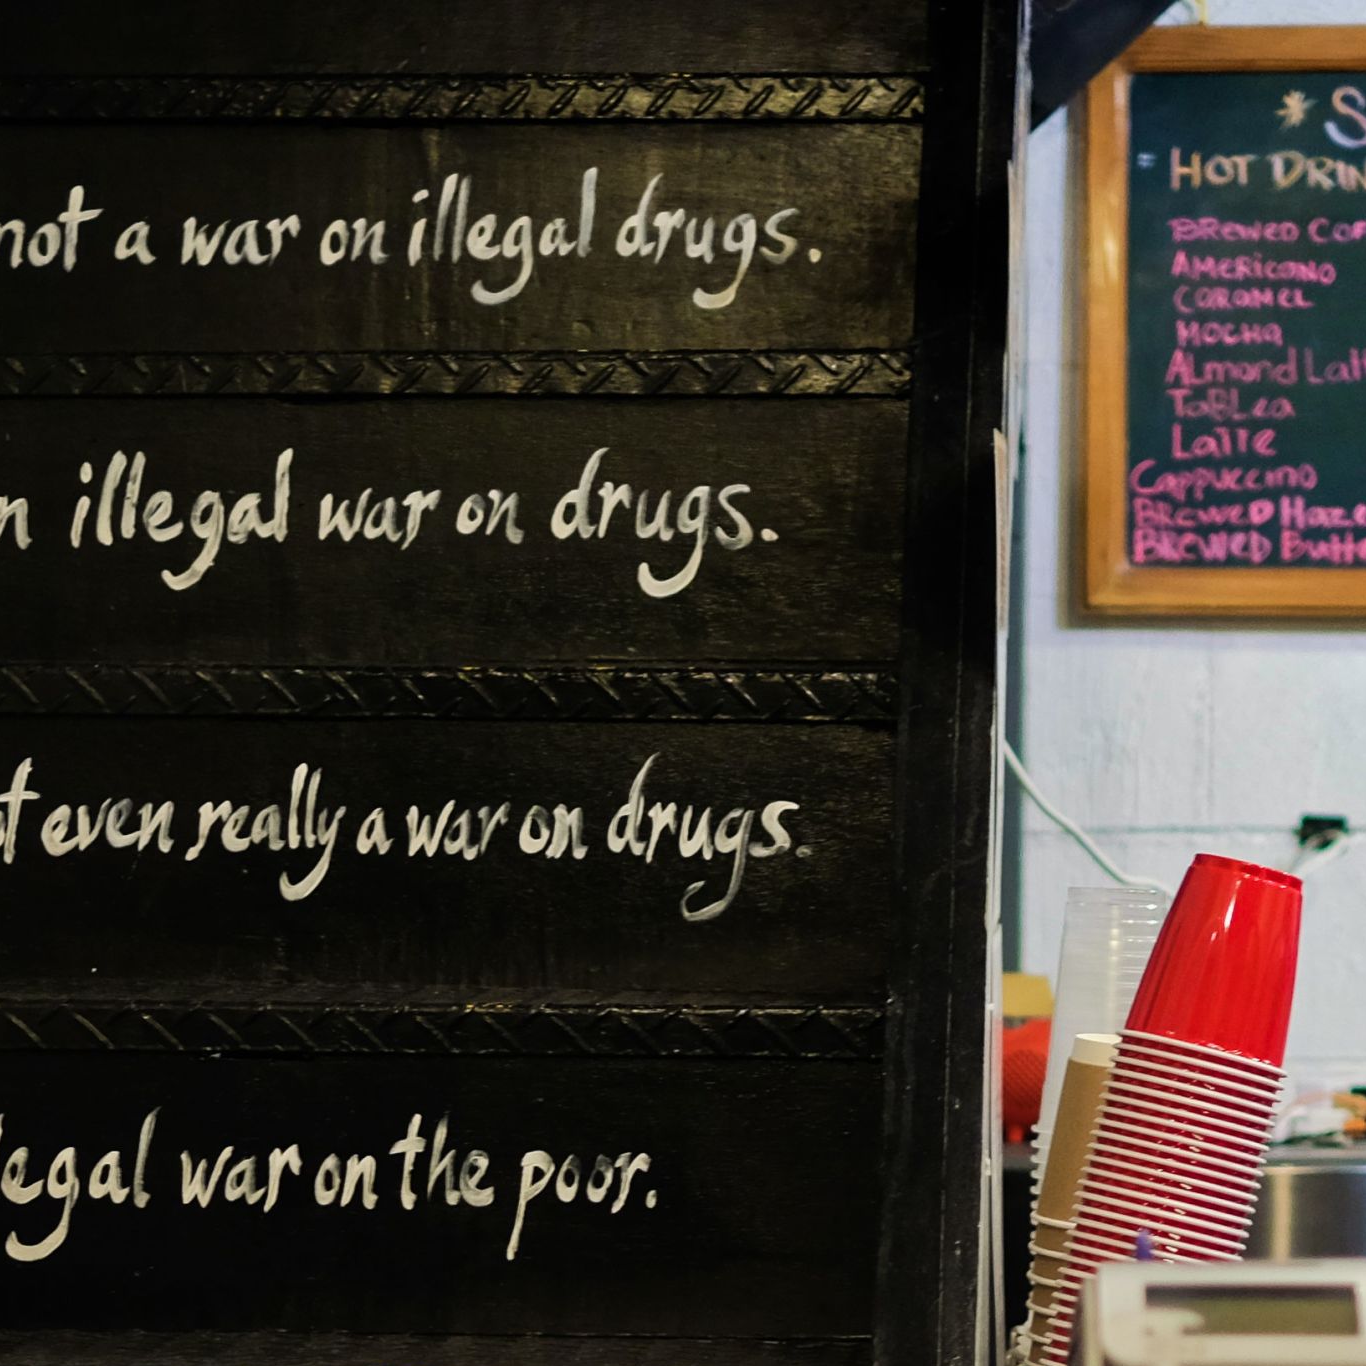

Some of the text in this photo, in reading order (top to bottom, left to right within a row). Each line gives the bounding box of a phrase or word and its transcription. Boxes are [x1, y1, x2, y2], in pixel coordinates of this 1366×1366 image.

[114, 217, 156, 265] a
[181, 214, 301, 267] war
[320, 216, 389, 266] on
[407, 166, 599, 305] illegal
[615, 173, 823, 310] drugs.
[1170, 147, 1255, 191] HOT
[69, 447, 295, 591] illegal
[317, 487, 441, 551] war
[455, 488, 525, 545] on
[549, 446, 780, 598] drugs.
[40, 797, 176, 857] even
[185, 761, 347, 902] really
[355, 806, 395, 857] a
[405, 799, 511, 862] war
[518, 802, 589, 860] on
[607, 750, 814, 923] drugs.
[180, 1143, 303, 1214] war
[313, 1152, 379, 1210] on
[388, 1112, 496, 1211] the
[505, 1149, 659, 1261] poor.
